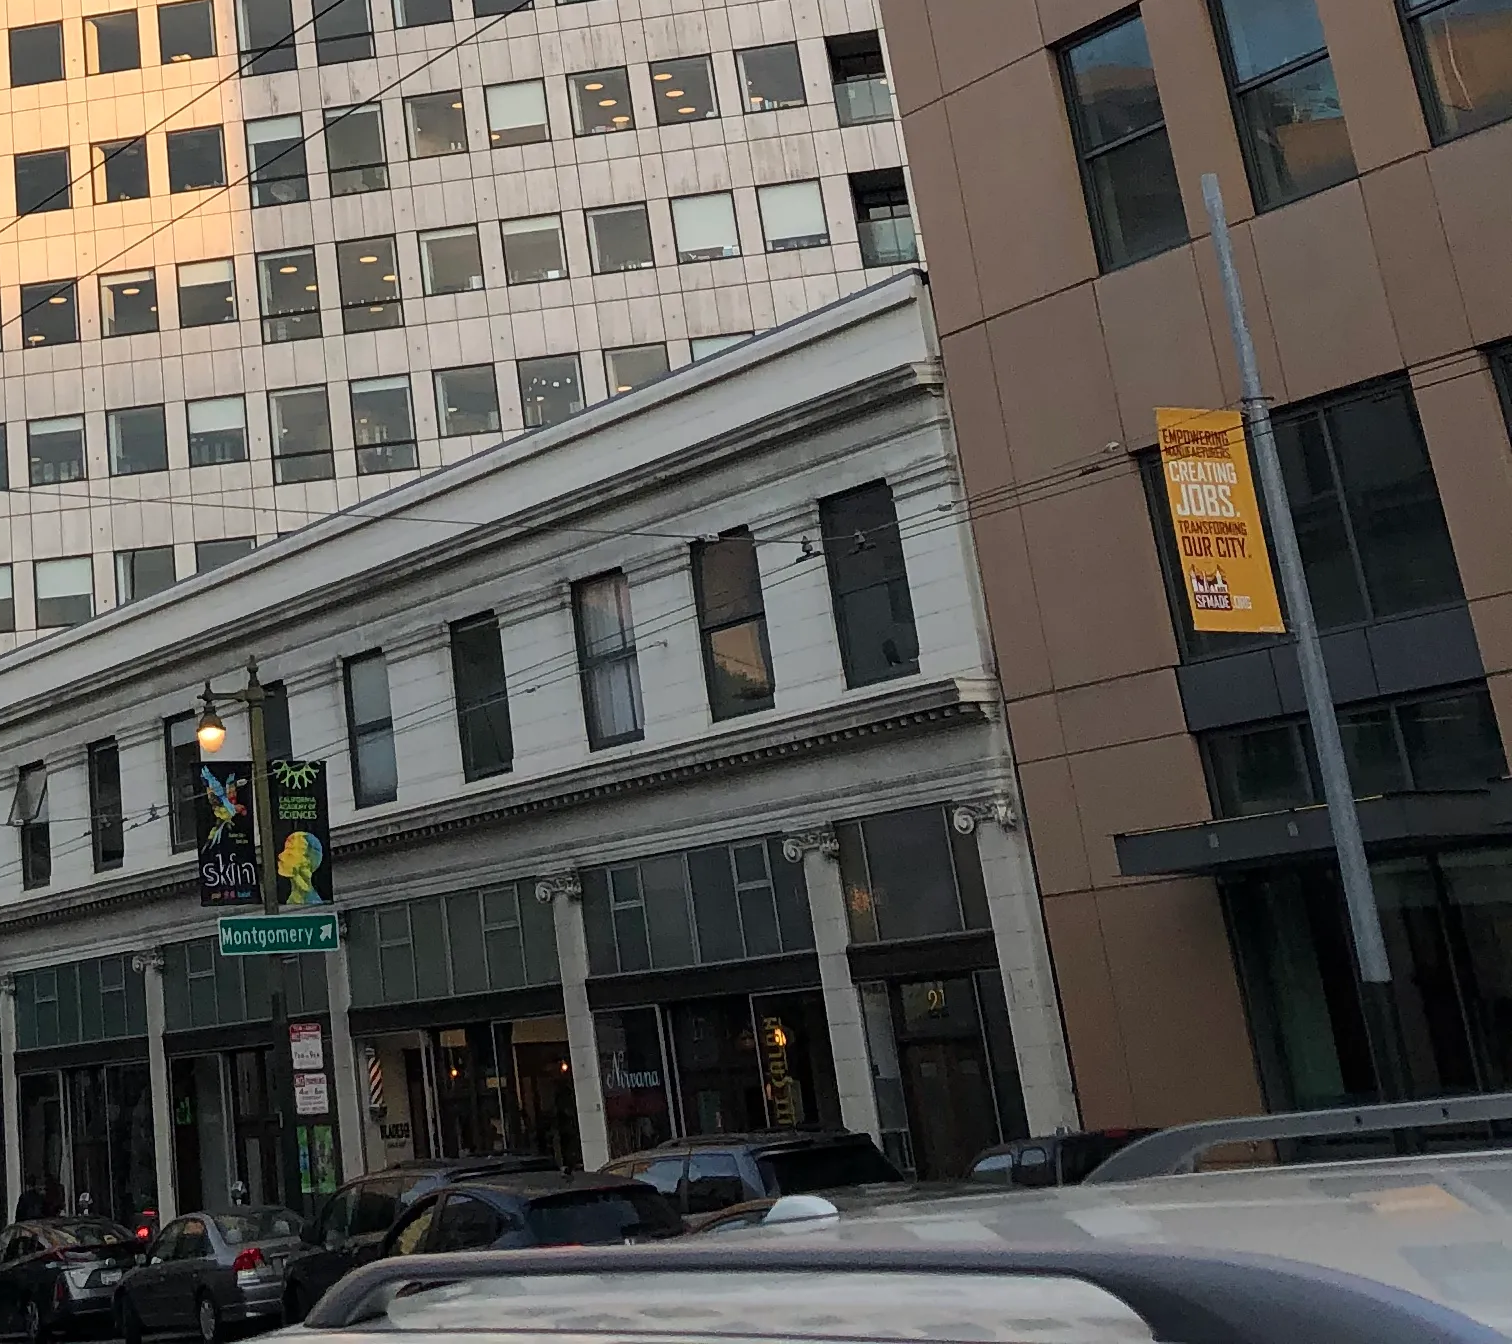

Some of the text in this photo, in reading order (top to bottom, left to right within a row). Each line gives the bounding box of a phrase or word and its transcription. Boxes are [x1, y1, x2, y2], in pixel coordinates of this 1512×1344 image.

[1161, 428, 1229, 446] EMPOWERING
[1168, 460, 1237, 484] CREATING
[1176, 484, 1240, 518] JOBS.
[1177, 520, 1247, 536] TRANSFORMING
[1182, 535, 1253, 559] OUR CITY.
[202, 852, 257, 887] skin
[221, 926, 314, 948] Montgomery
[606, 1051, 661, 1089] Nirvana
